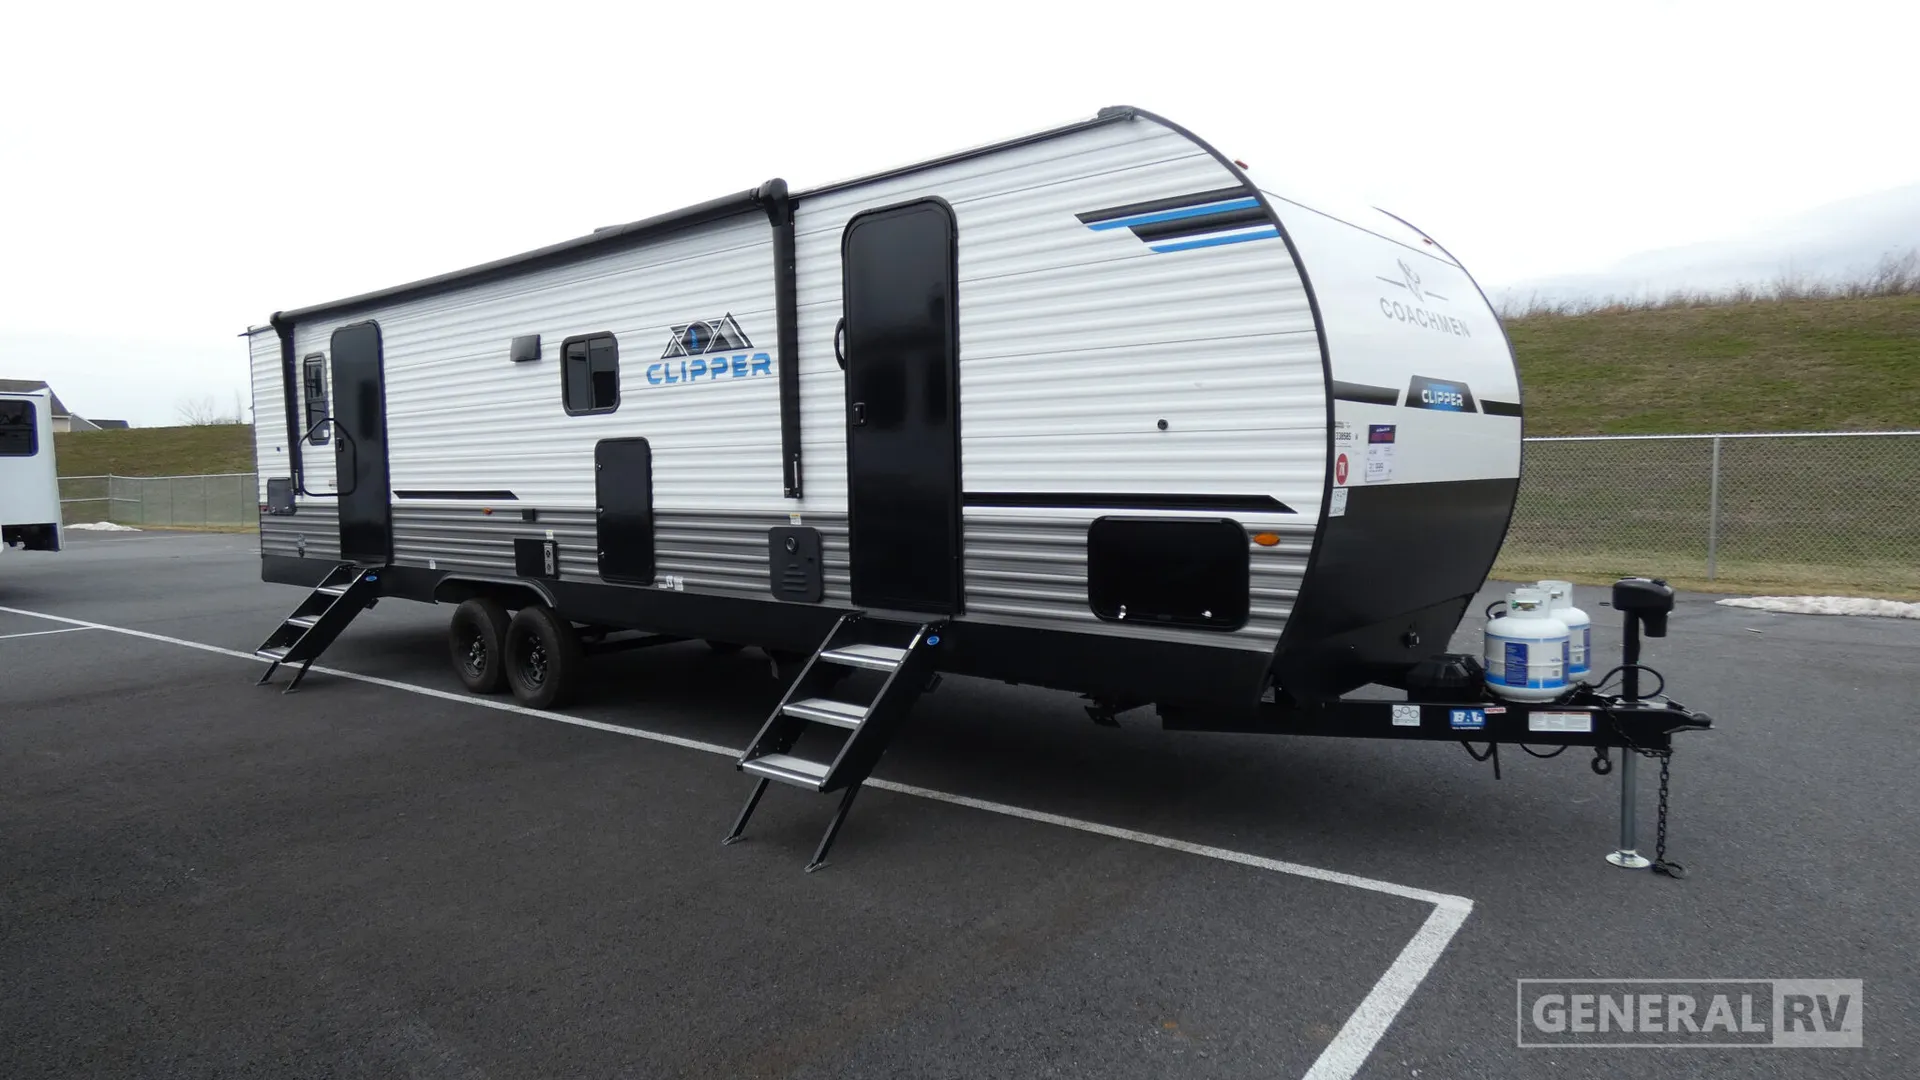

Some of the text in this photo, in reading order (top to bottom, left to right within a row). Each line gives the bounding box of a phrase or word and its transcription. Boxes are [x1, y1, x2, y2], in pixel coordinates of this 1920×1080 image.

[1379, 297, 1471, 338] COACHMEN
[646, 352, 772, 385] CLIPPER
[1421, 389, 1464, 407] CLIPPER
